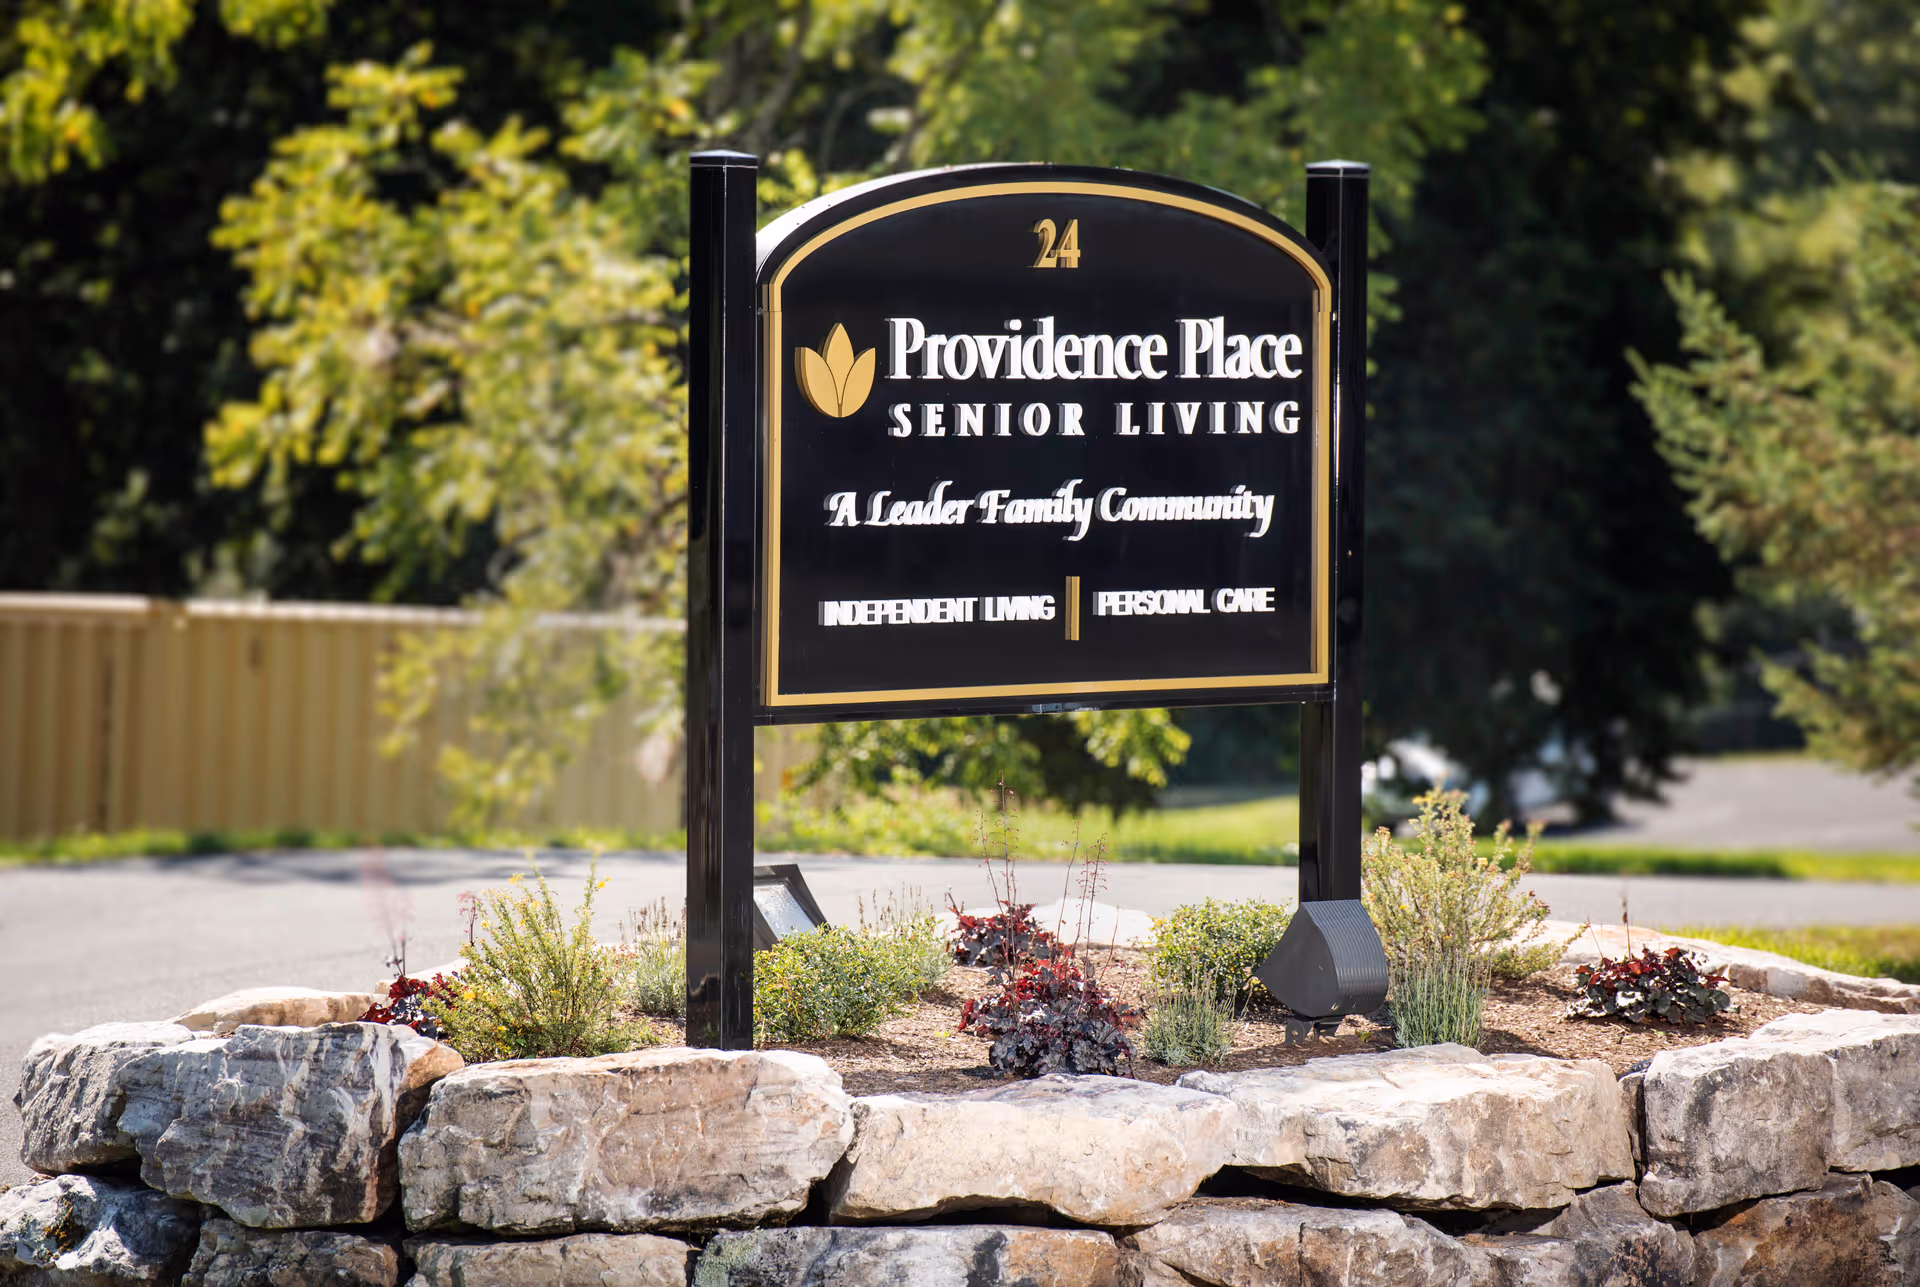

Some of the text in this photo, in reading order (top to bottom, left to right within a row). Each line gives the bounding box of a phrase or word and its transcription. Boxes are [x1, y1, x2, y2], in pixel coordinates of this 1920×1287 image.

[1029, 218, 1081, 269] 24
[887, 315, 1303, 381] Providence Place
[889, 401, 1301, 437] SENIOR LIVING
[825, 479, 1275, 541] A Leader Family Community
[820, 595, 1056, 626] INDEPENDENT LIVING
[1093, 587, 1276, 616] PERSONAL CARE
